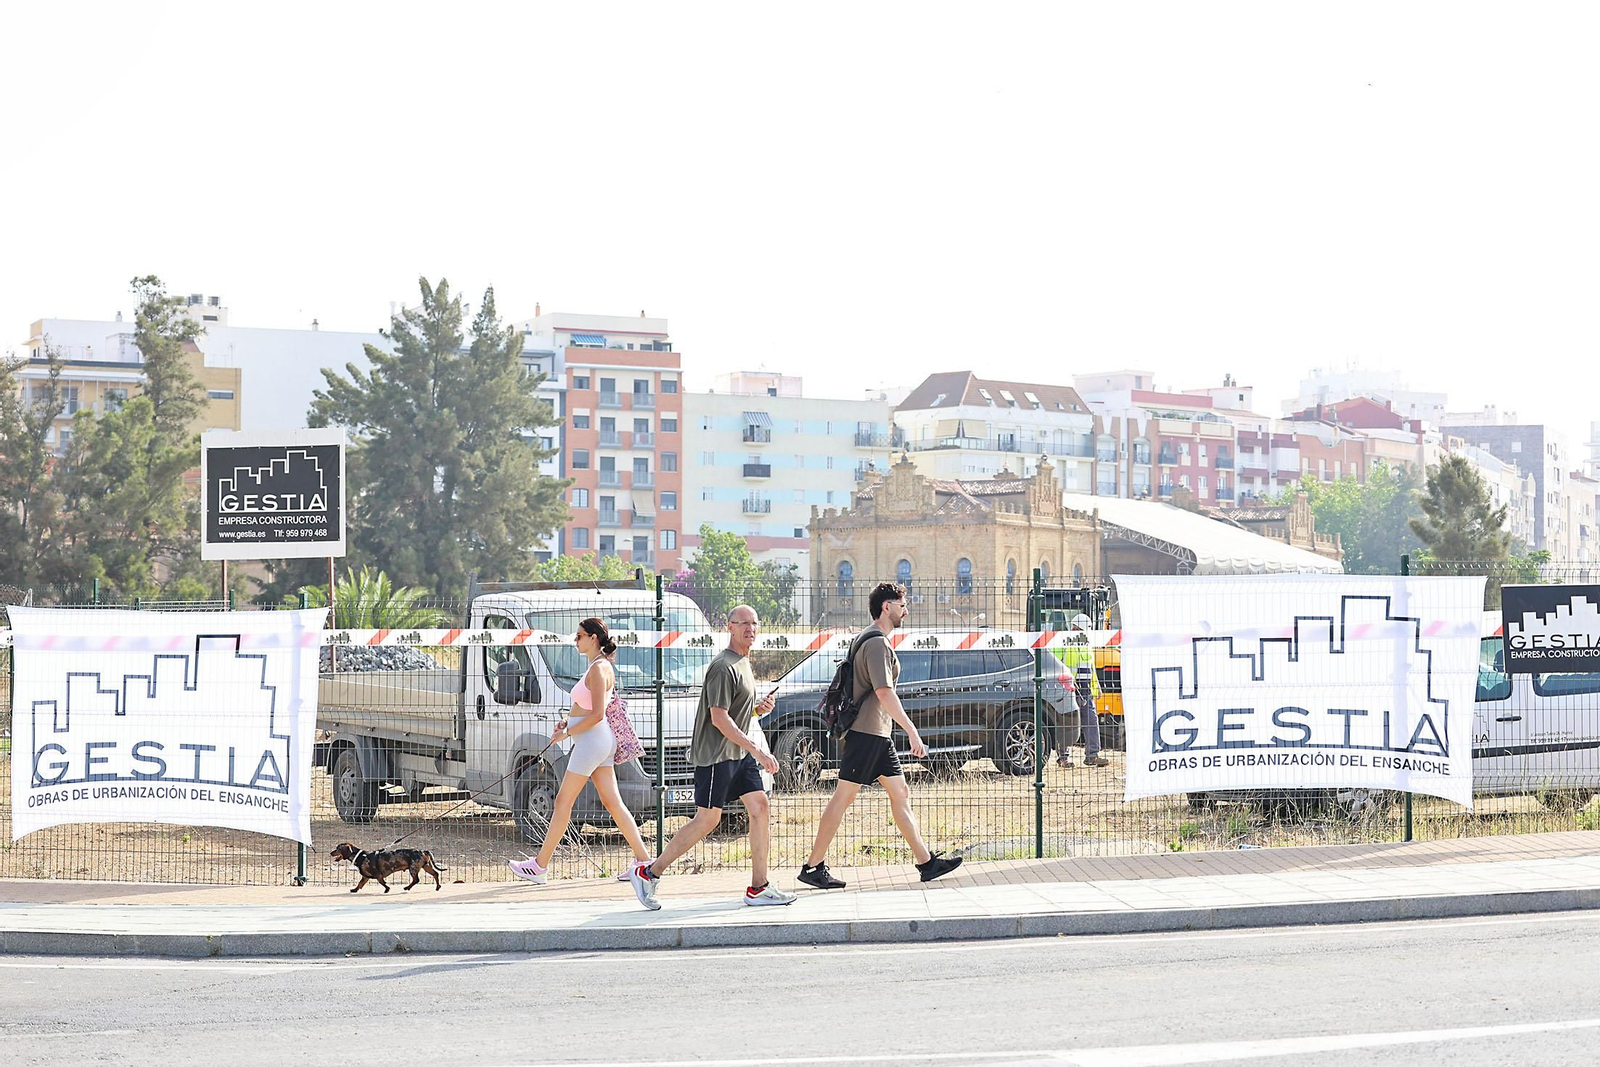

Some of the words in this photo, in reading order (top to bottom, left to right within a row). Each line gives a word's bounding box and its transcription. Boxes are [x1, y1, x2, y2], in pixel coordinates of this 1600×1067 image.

[221, 493, 326, 511] GESTIA
[219, 516, 258, 525] EMPRESA
[259, 515, 327, 524] CONSTRUCTORA
[219, 530, 266, 539] www.gestia.es
[286, 529, 299, 537] 959
[300, 529, 313, 537] 979
[314, 529, 327, 537] 468
[1511, 651, 1547, 659] EMPRESA
[1548, 649, 1600, 658] CONSTRUCTO
[1154, 706, 1449, 757] GESTIA
[1475, 733, 1490, 743] IA
[33, 741, 288, 794] GESTIA
[1148, 755, 1198, 773] OBRAS
[1202, 755, 1222, 768] DE
[1225, 751, 1335, 767] URBANIZACIÓN
[1340, 754, 1368, 767] DEL
[1372, 756, 1451, 776] ENSANCHE
[27, 788, 69, 808] OBRAS
[72, 788, 89, 800] DE
[92, 784, 186, 799] URBANIZACIÓN
[190, 788, 215, 802] DEL
[218, 791, 290, 813] ENSANCHE
